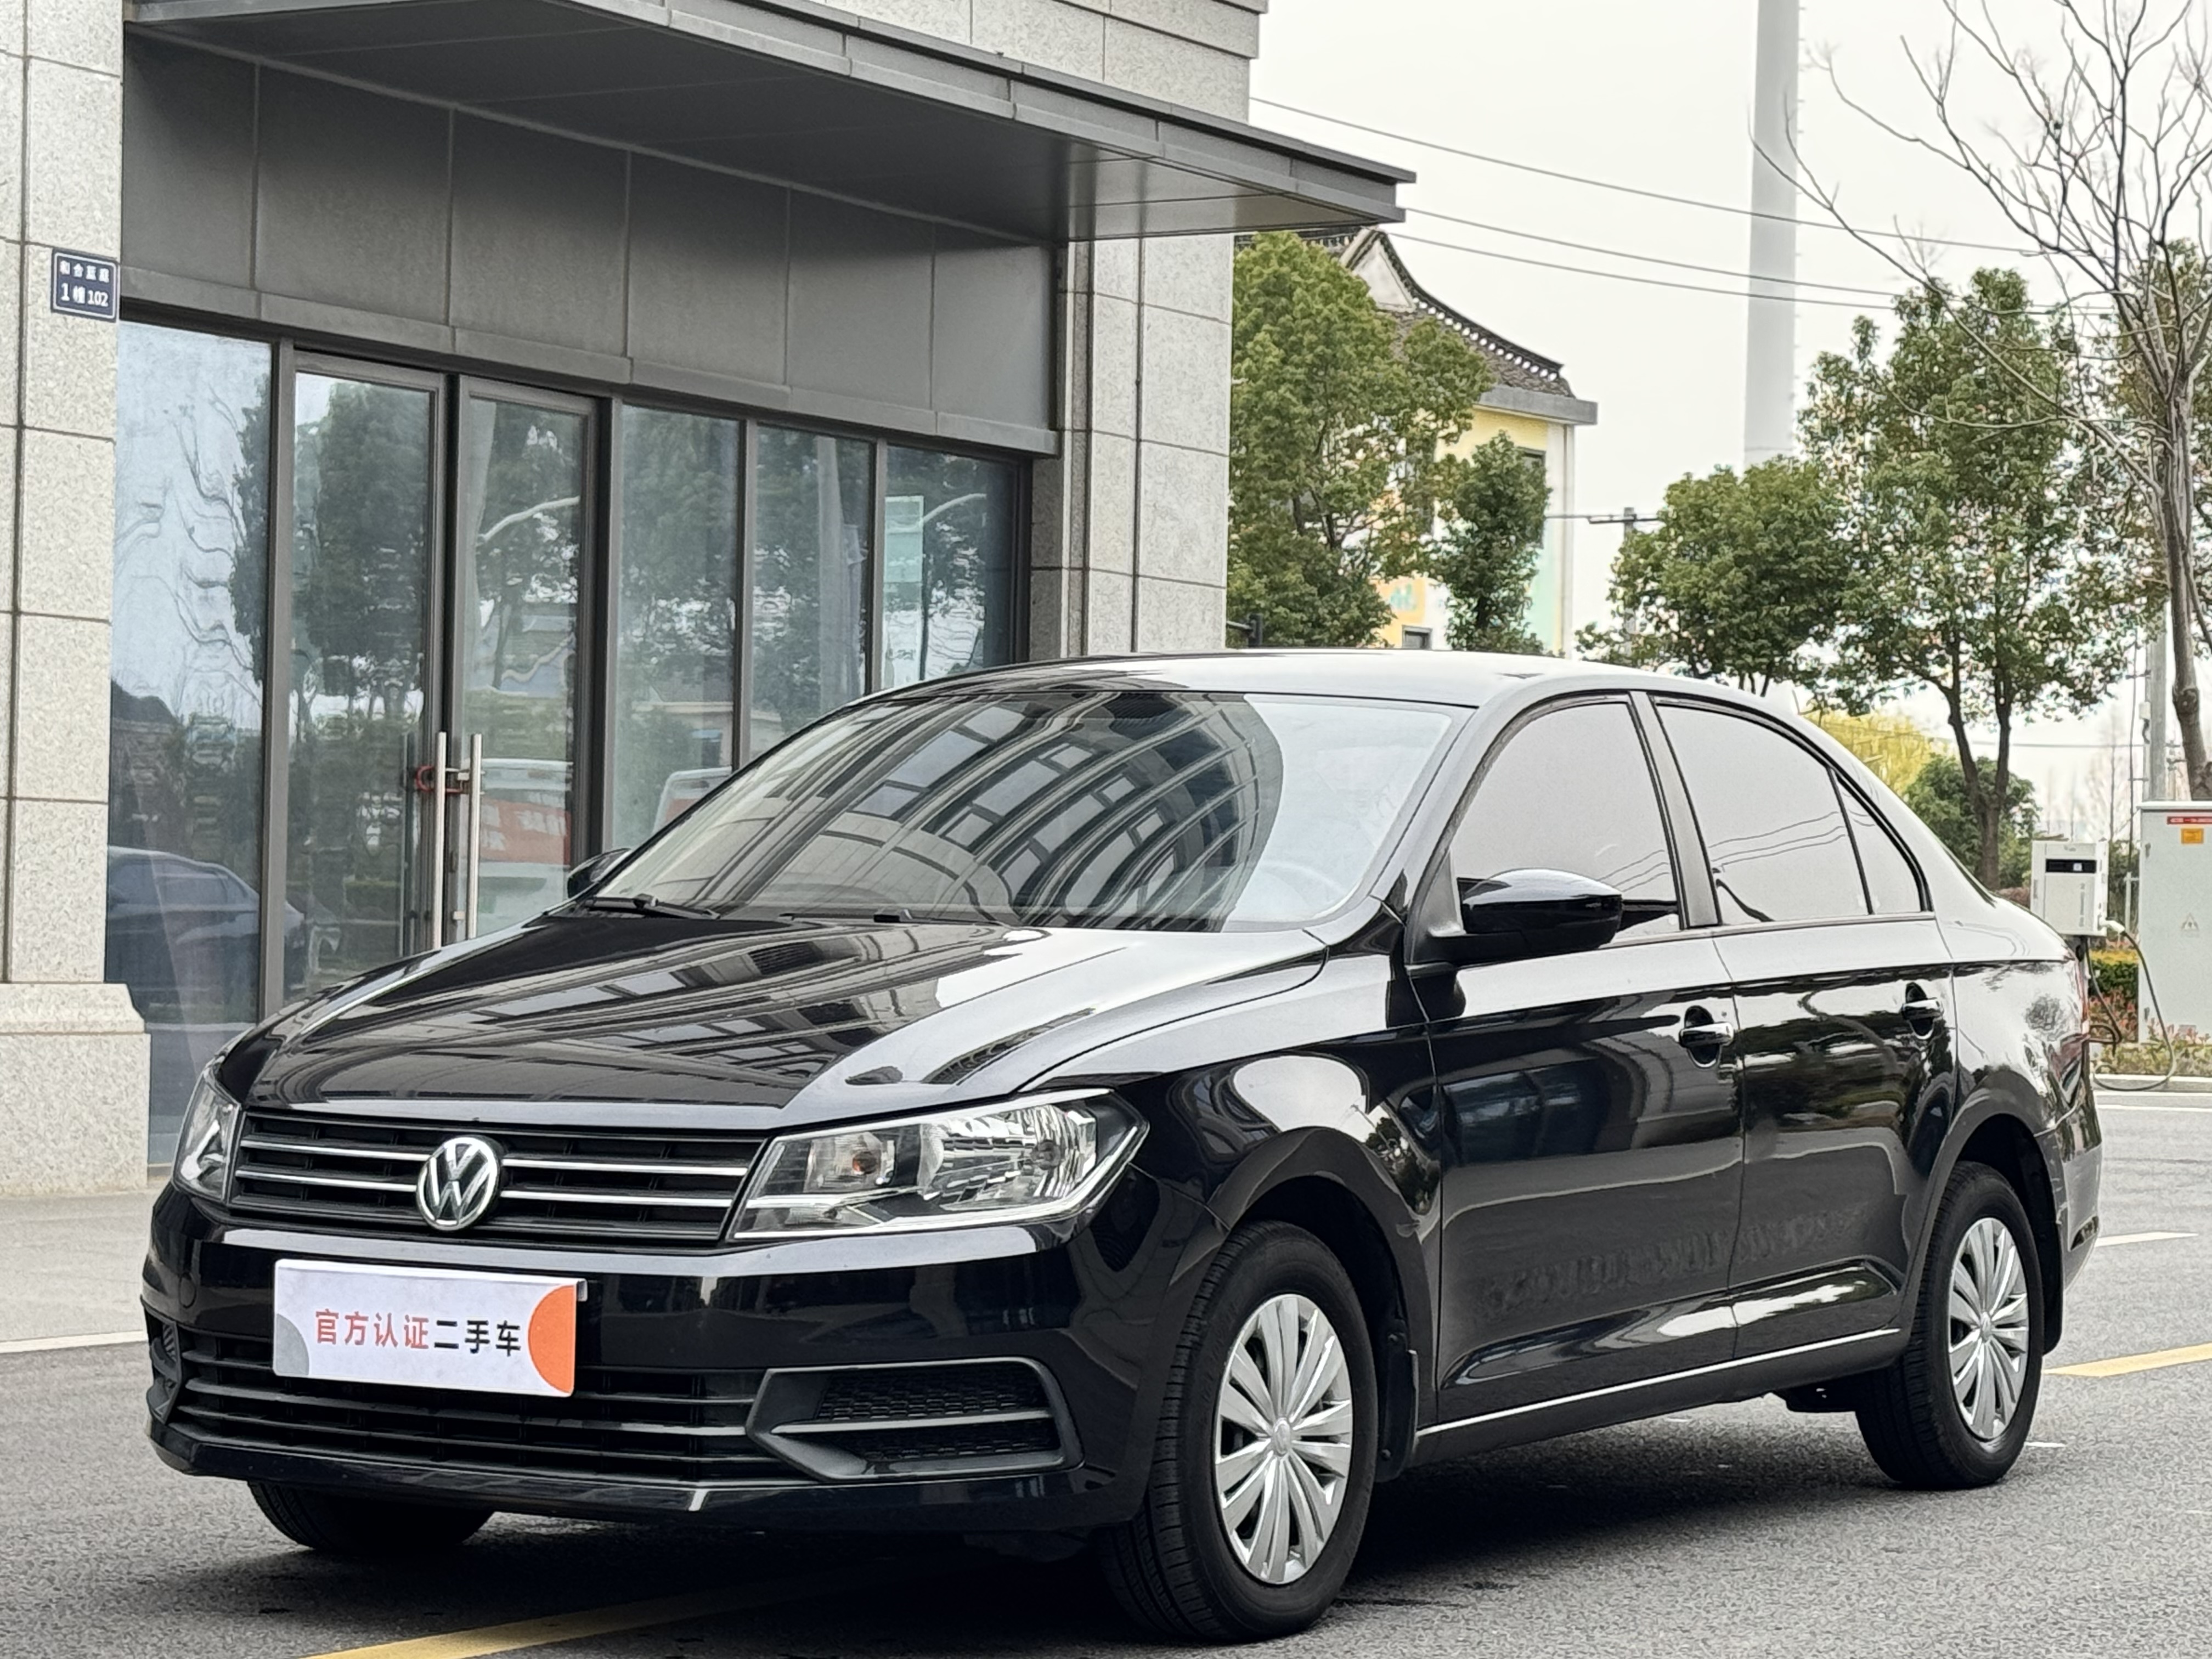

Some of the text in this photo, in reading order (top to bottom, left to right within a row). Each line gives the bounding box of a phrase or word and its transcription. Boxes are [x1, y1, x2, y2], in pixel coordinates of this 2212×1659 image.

[315, 1308, 521, 1357] 官方认证二手车
